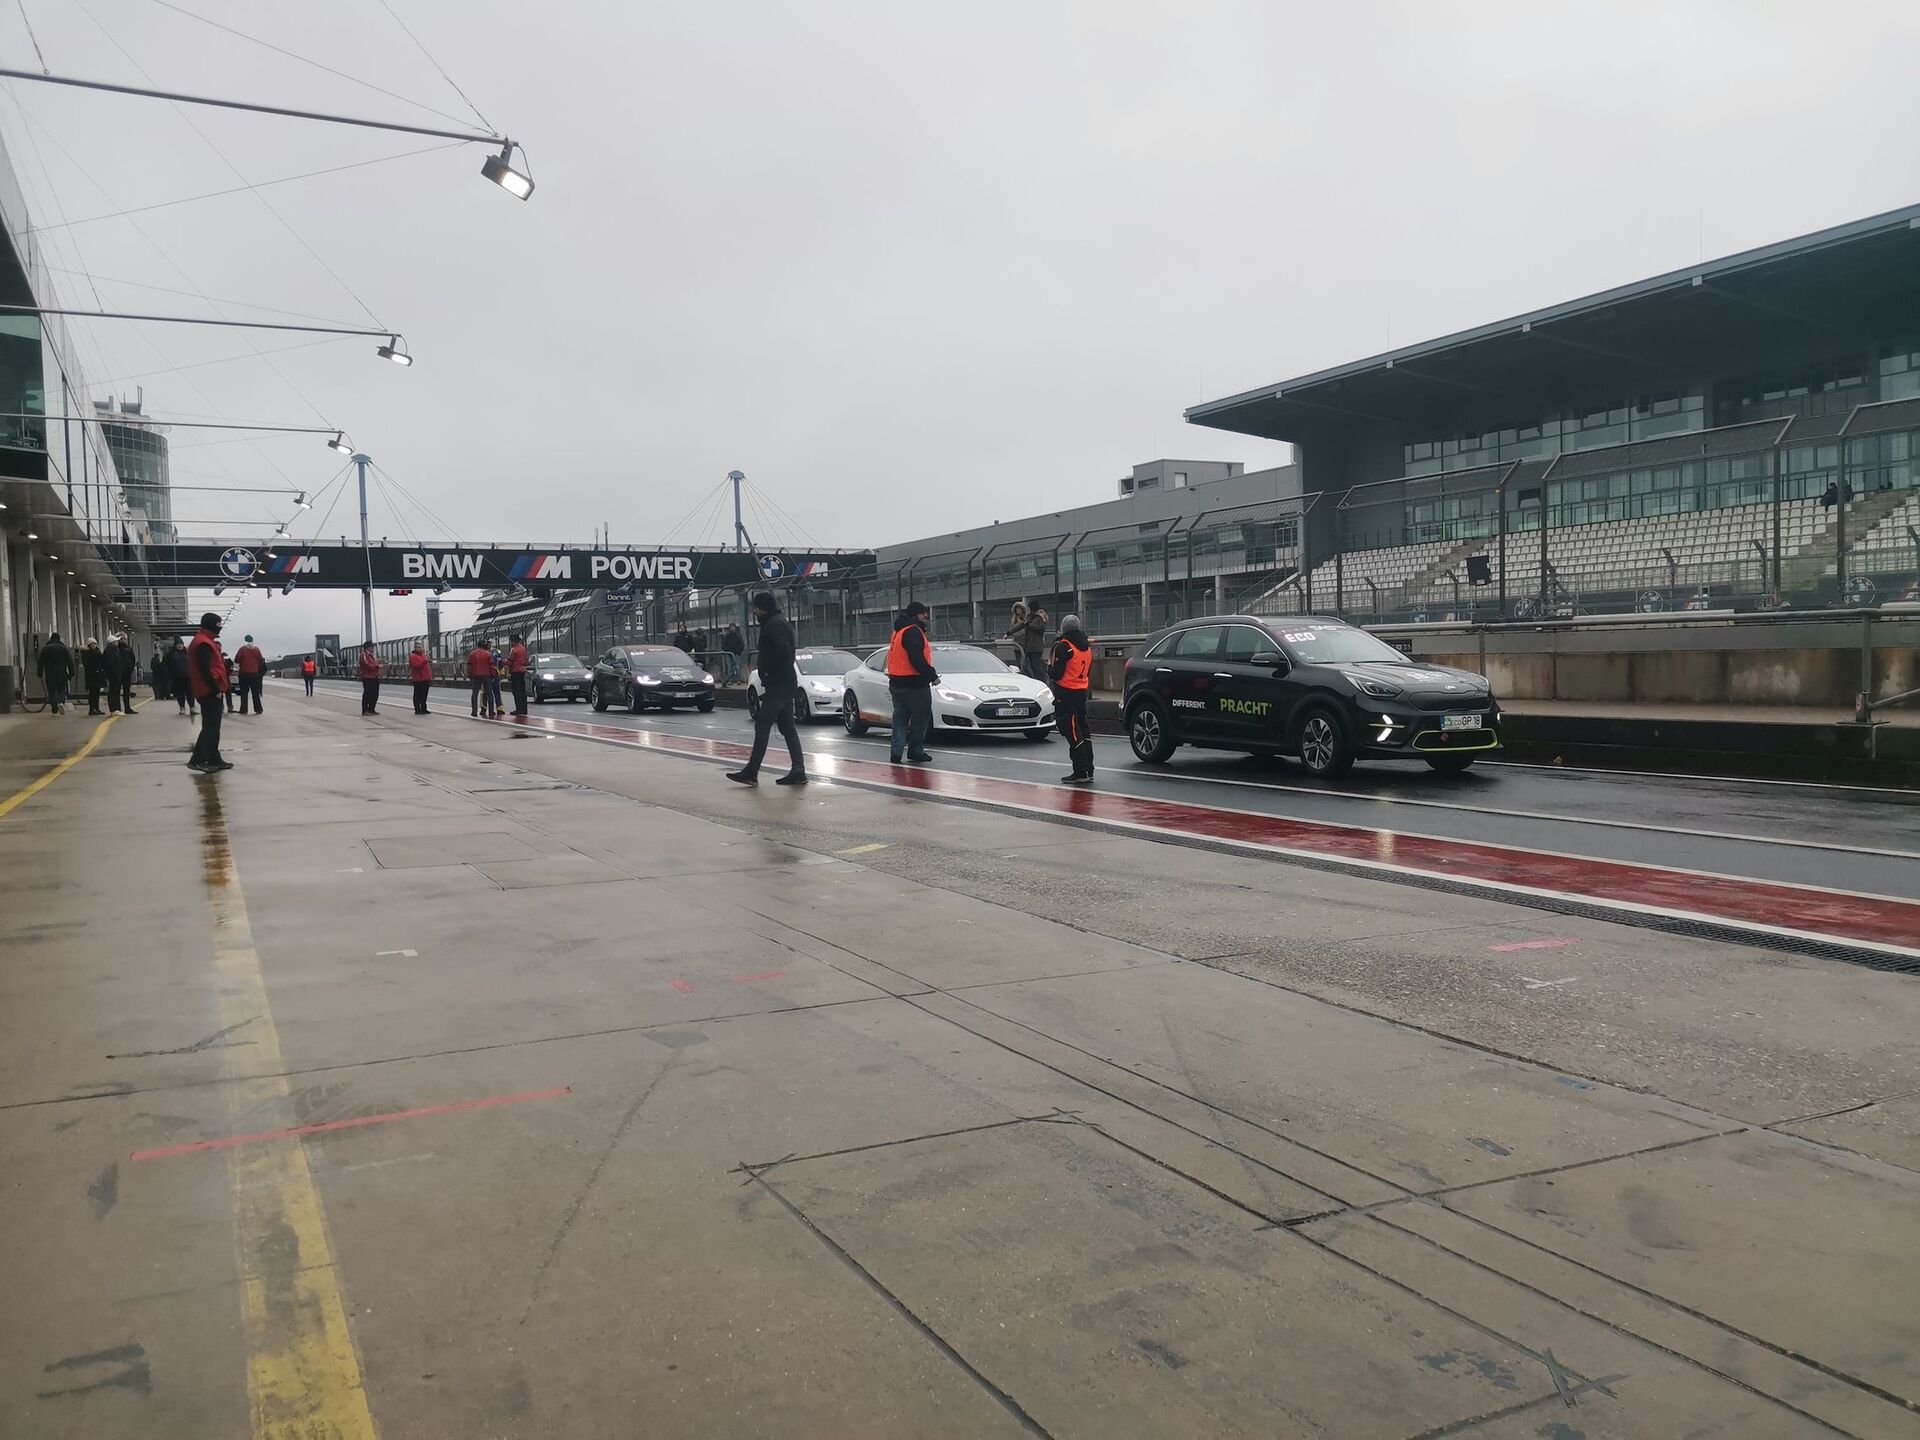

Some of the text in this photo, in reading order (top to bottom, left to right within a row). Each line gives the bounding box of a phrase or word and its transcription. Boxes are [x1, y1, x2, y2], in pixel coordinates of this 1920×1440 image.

[402, 553, 693, 580] BMW M POWER
[1284, 631, 1316, 643] ECO
[1172, 699, 1207, 709] DIFFERENT.
